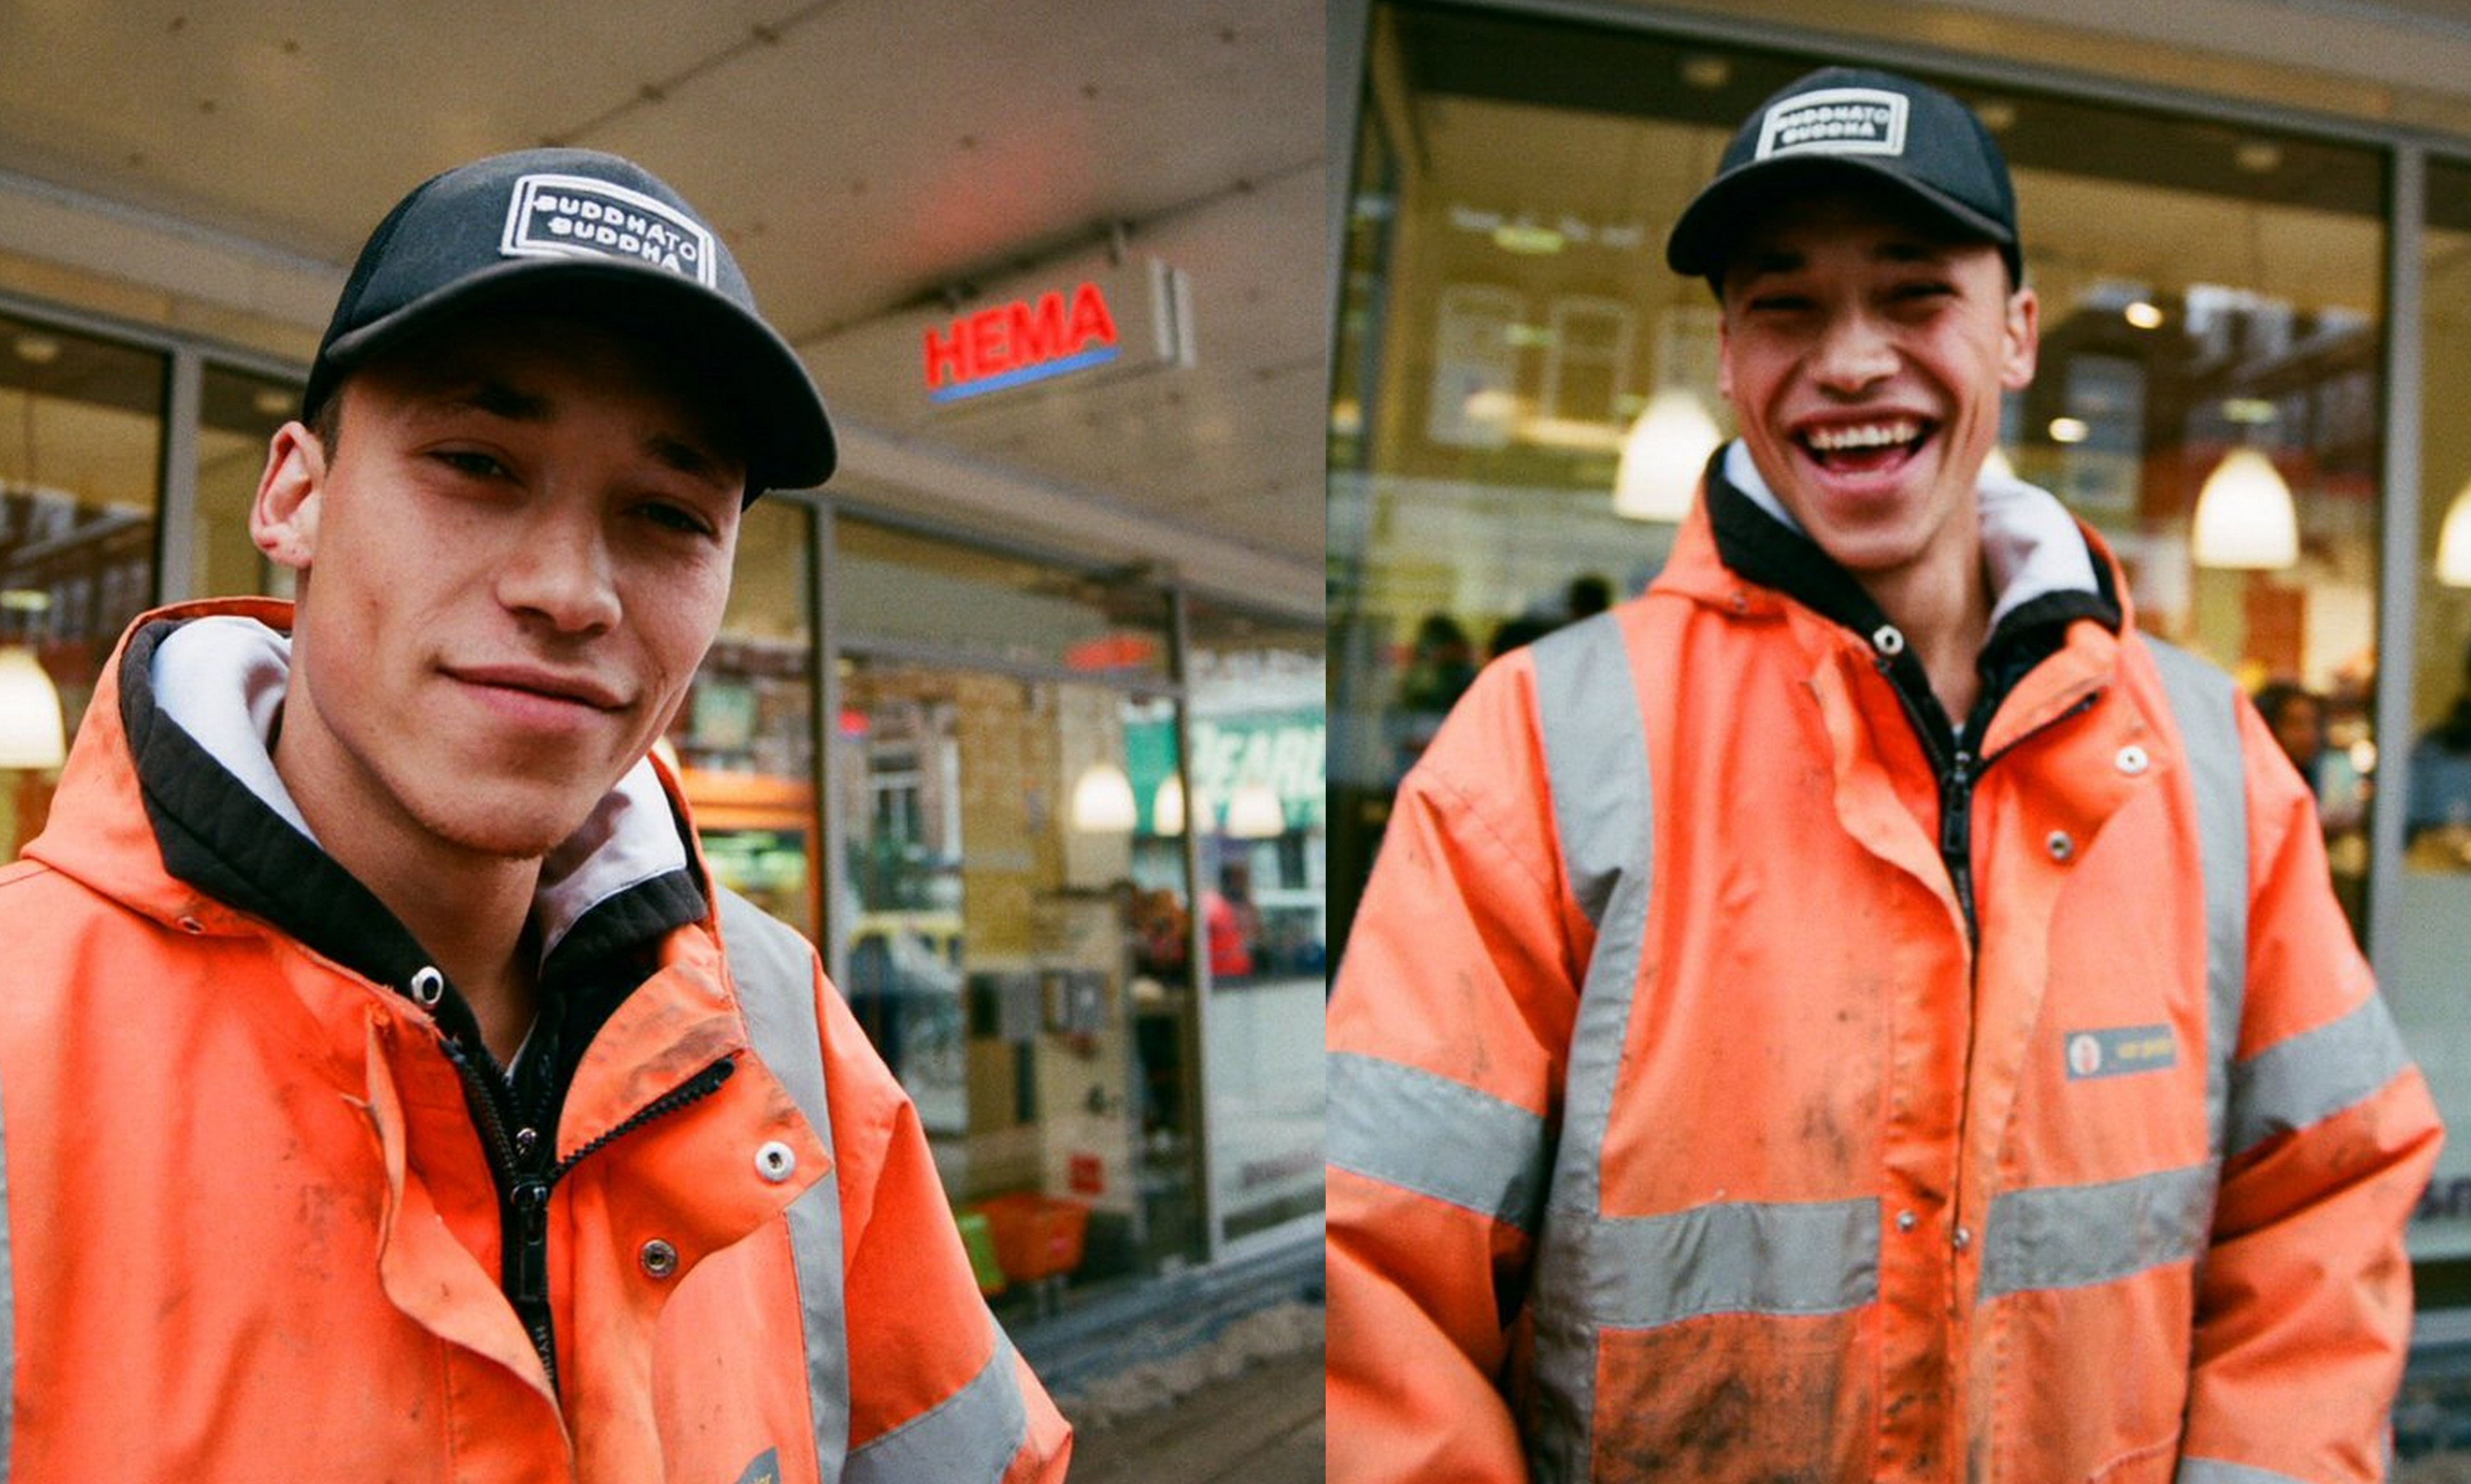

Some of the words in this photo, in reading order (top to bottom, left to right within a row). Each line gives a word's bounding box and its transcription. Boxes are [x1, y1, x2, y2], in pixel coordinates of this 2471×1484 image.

[1782, 121, 1875, 144] BUDDHA
[547, 216, 681, 273] BUDDHA
[924, 281, 1117, 389] HEMA
